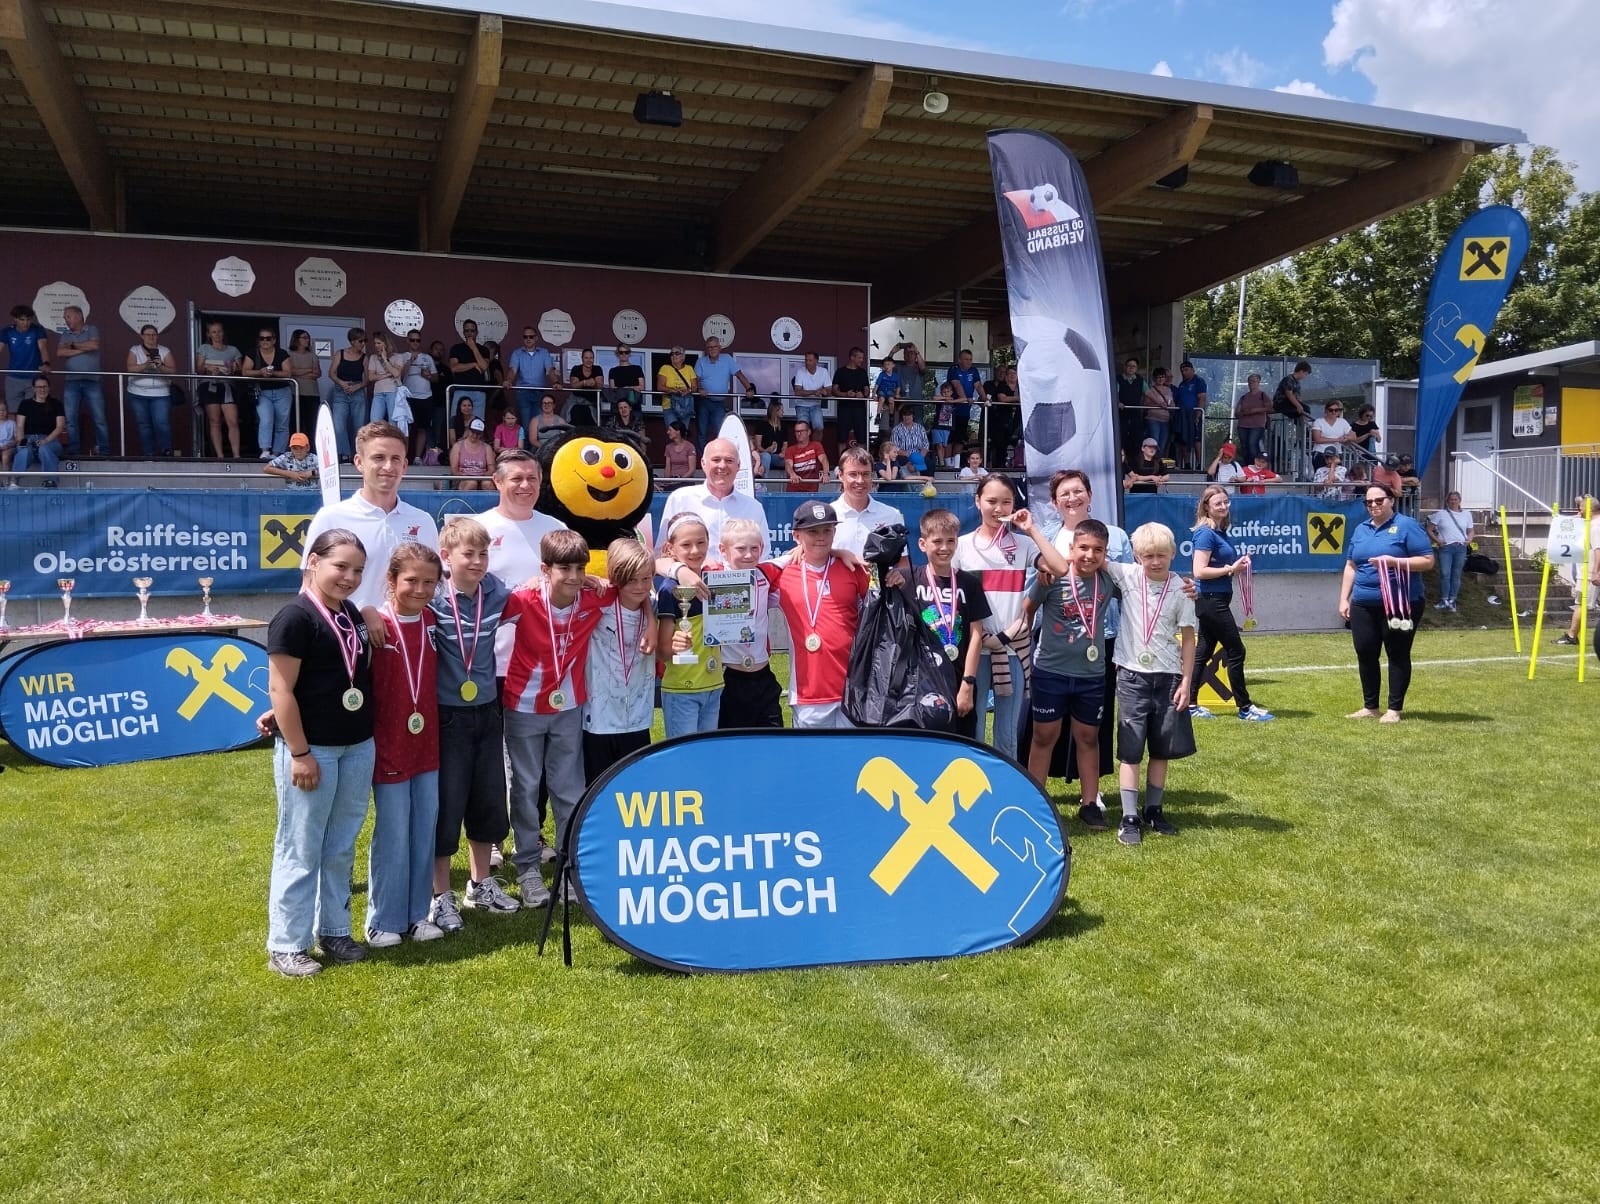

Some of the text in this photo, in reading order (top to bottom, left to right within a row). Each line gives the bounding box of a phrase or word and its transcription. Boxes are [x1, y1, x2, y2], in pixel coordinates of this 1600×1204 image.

[1514, 425, 1535, 434] WM 26
[107, 523, 248, 547] Raiffeisen
[33, 549, 248, 574] Oberösterreich
[1560, 544, 1572, 557] 2
[19, 672, 75, 697] WIR
[28, 713, 160, 750] MÖGLICH
[615, 790, 704, 828] WIR
[618, 875, 837, 926] MÖGLICH
